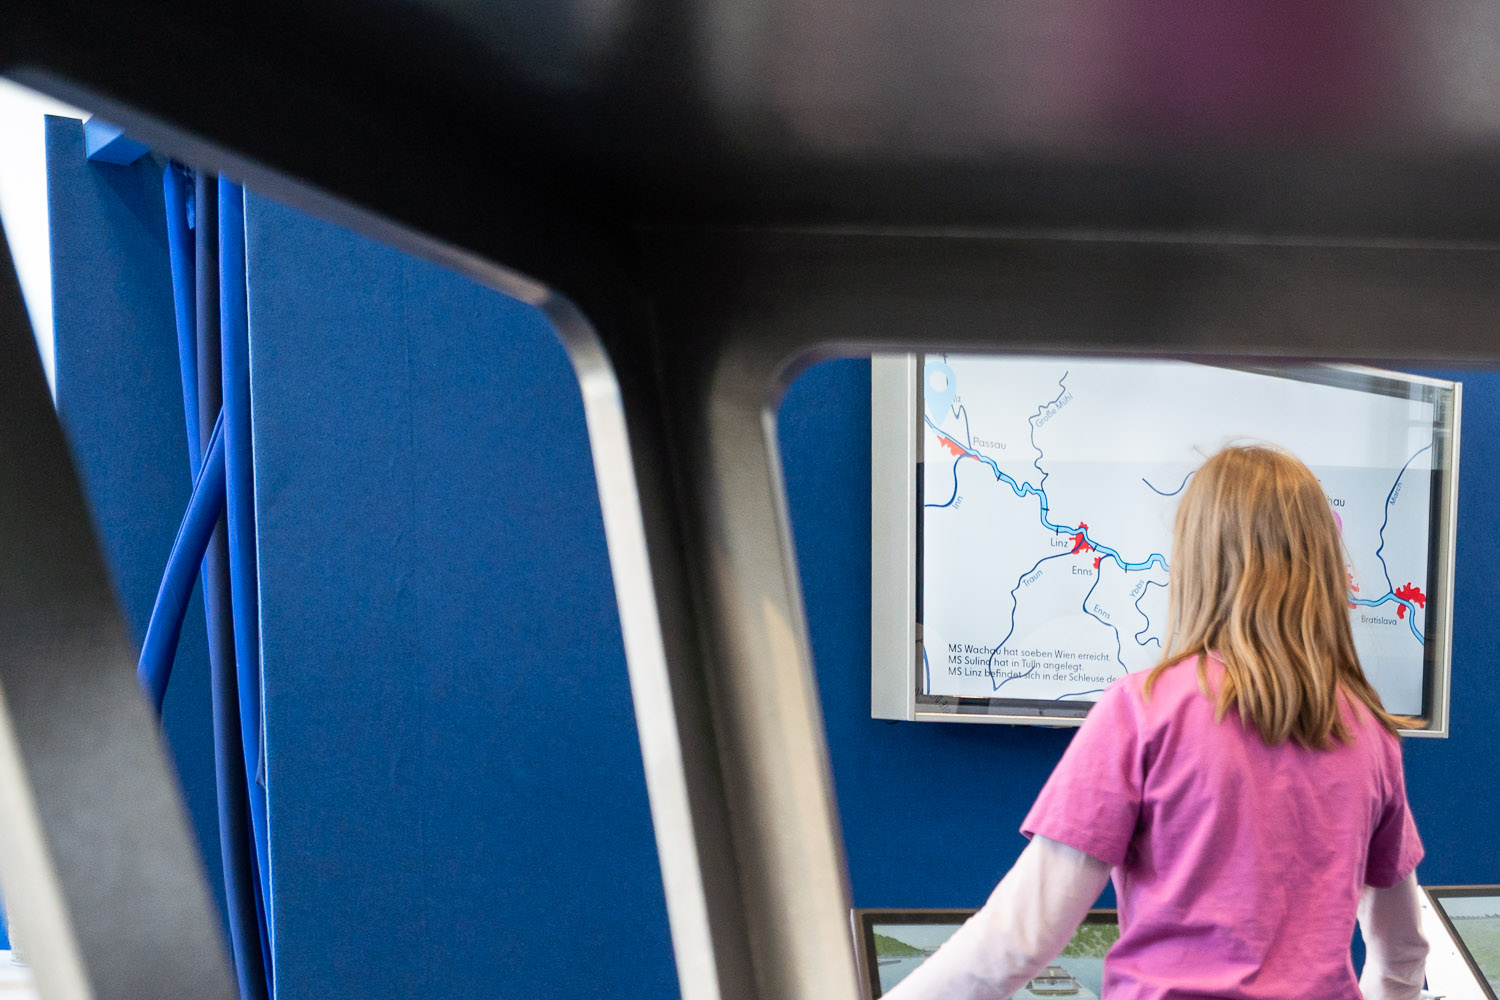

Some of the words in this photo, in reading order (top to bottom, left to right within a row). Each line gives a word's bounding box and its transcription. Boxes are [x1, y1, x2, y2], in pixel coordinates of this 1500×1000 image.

[973, 437, 1007, 450] Passau
[1390, 482, 1403, 506] March
[952, 495, 963, 510] Inn
[1050, 537, 1068, 548] Linz
[1022, 569, 1043, 588] Traun
[1072, 566, 1093, 576] Enns
[1129, 579, 1145, 598] Ybbs
[1093, 604, 1111, 620] Enns
[1361, 615, 1398, 626] Bratislava
[948, 643, 962, 653] MS
[964, 644, 1002, 655] Wachau
[1003, 647, 1018, 656] hat
[1021, 648, 1052, 658] soeben
[1054, 650, 1075, 659] Wien
[948, 655, 962, 664] MS
[994, 657, 1009, 667] hat
[1011, 658, 1020, 667] in
[1021, 659, 1041, 669] Tulln
[948, 666, 962, 676] MS
[964, 667, 982, 677] Linz
[984, 668, 1022, 678] befindet
[1042, 671, 1051, 680] in
[1052, 671, 1067, 681] der
[1069, 672, 1105, 683] Schleuse
